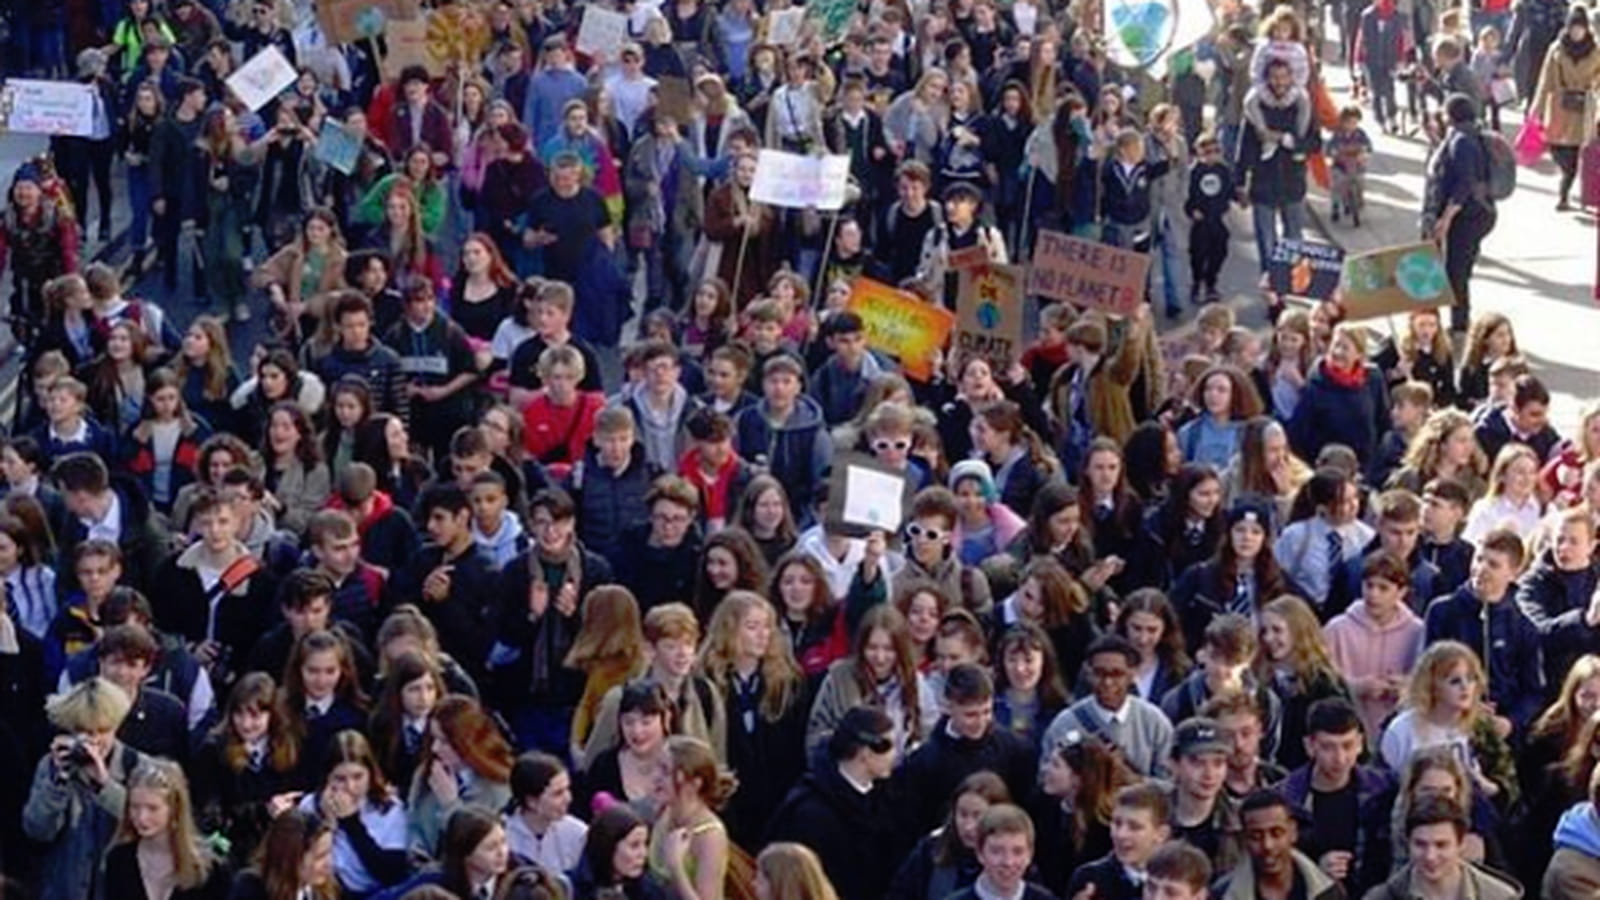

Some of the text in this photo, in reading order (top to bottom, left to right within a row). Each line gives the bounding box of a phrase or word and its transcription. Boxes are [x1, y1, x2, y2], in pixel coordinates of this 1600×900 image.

[1041, 235, 1104, 269] THERE
[1034, 267, 1055, 291] NO
[1057, 272, 1119, 306] PLANET
